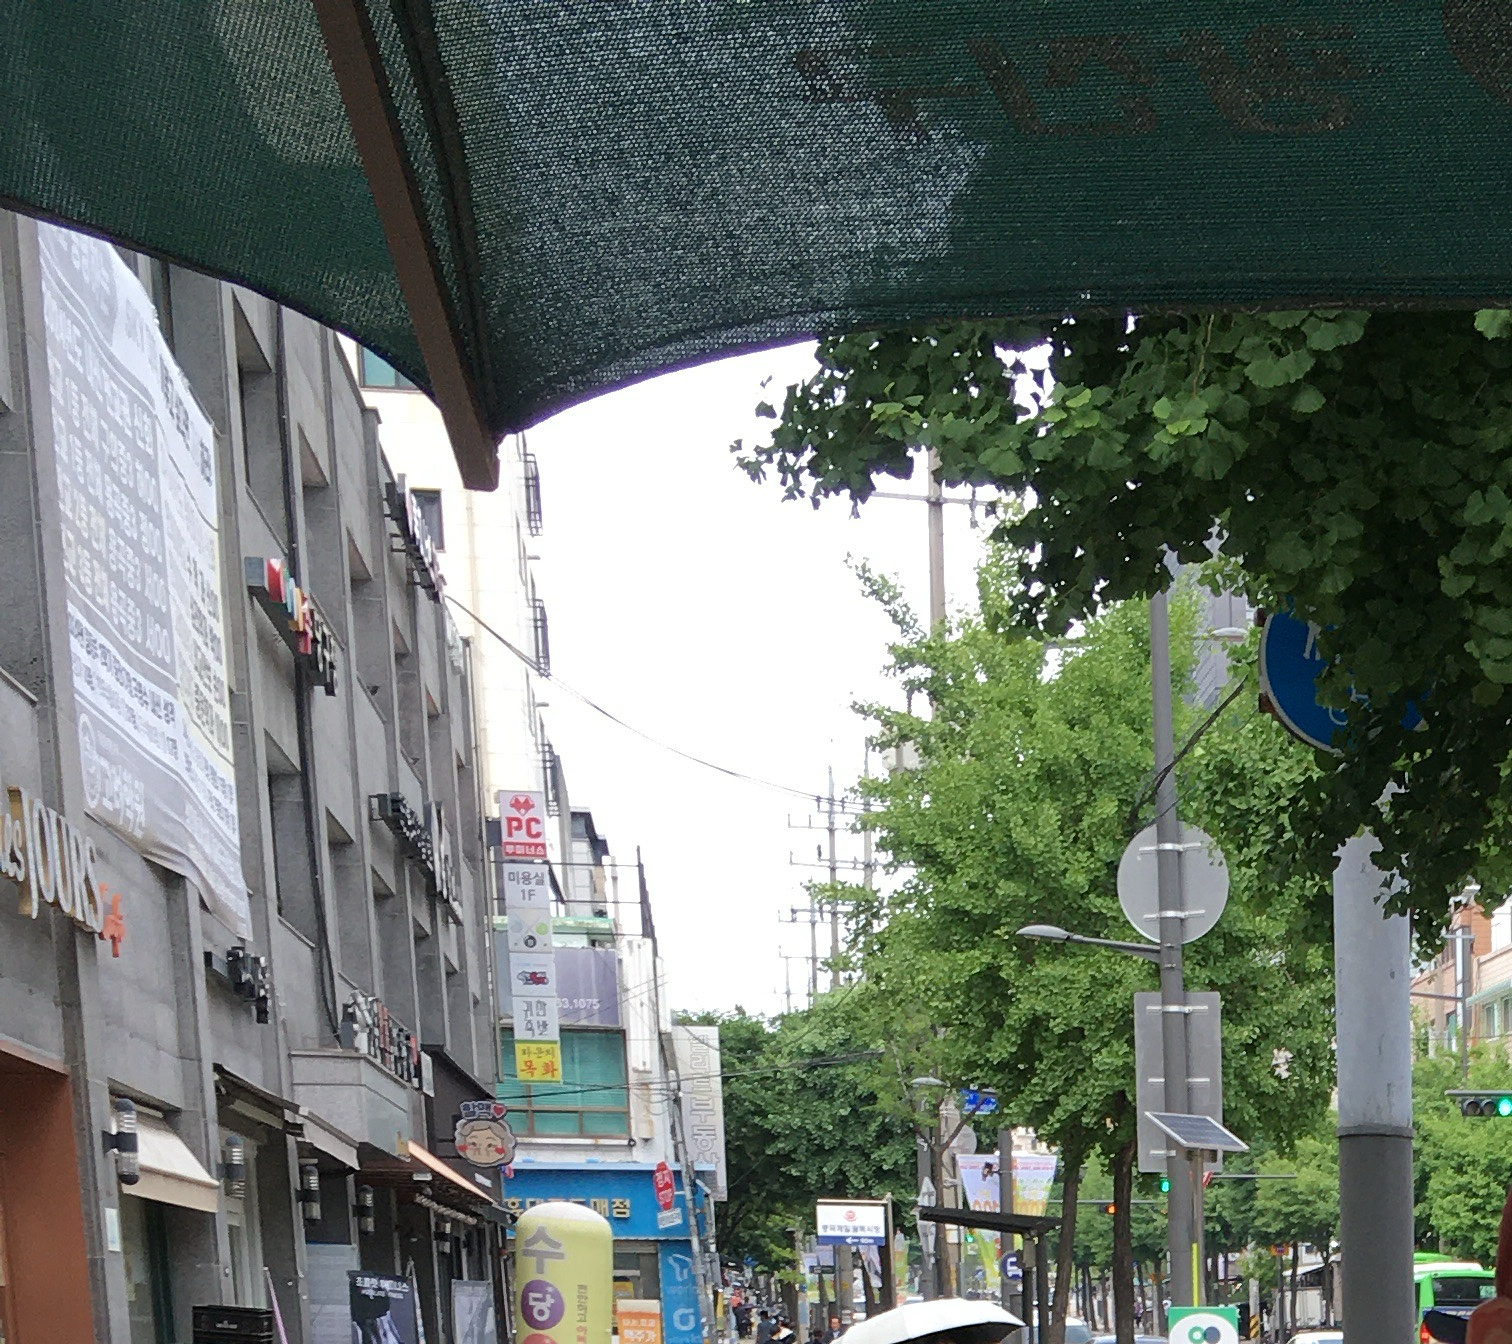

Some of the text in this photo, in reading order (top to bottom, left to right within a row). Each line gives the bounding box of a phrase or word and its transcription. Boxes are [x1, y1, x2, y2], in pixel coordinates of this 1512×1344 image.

[505, 816, 543, 839] PC
[20, 787, 104, 934] JOURS
[507, 870, 546, 886] 미용실
[519, 888, 536, 902] 1F
